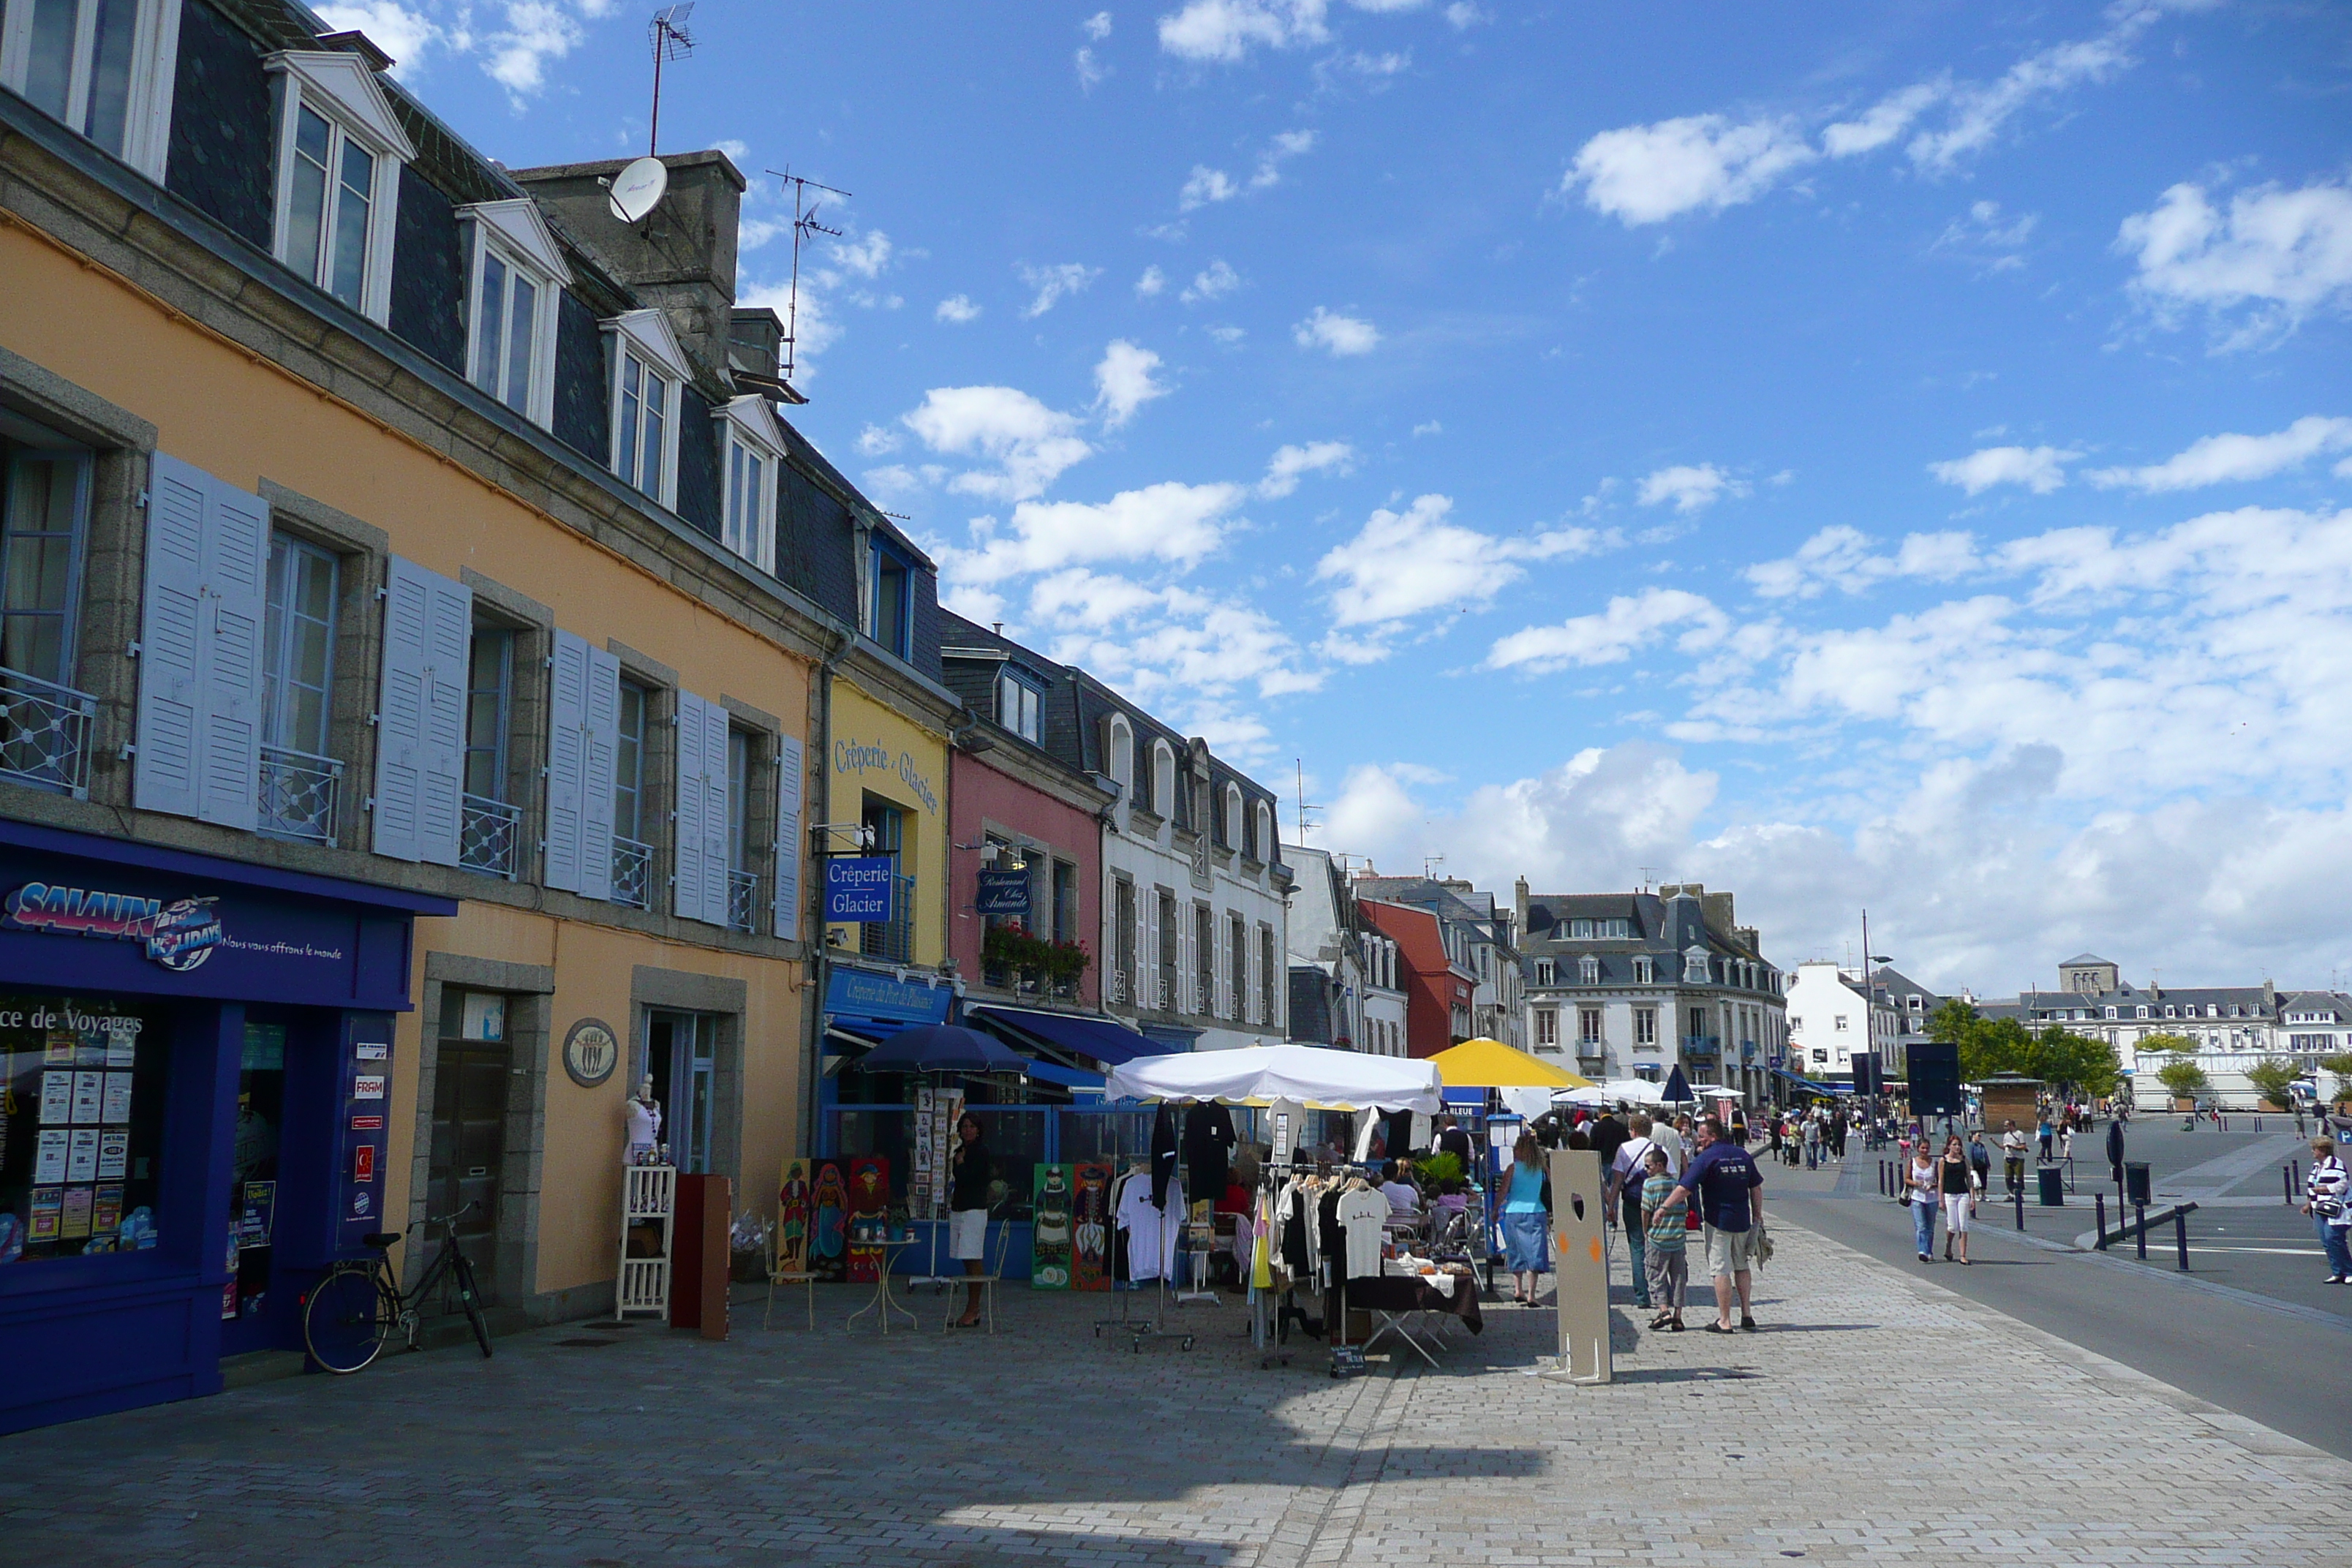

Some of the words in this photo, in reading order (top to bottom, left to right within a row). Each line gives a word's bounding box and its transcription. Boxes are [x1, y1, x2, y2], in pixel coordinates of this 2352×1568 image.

[834, 737, 888, 775] Crêperie
[899, 751, 938, 816] Glacier
[829, 864, 889, 886] Crêperie
[981, 875, 1028, 887] Restaurant
[979, 893, 1028, 909] Armande
[1003, 886, 1024, 898] Chez
[14, 881, 162, 937] SALAUN
[833, 893, 883, 913] Glacier
[151, 924, 221, 957] HOLIDAYS
[222, 935, 246, 949] Nous
[248, 943, 270, 951] vous
[271, 941, 304, 955] offrons
[306, 943, 312, 955] le
[314, 949, 342, 960] monde
[31, 1005, 56, 1030] de
[66, 1009, 143, 1038] Voyages
[356, 1082, 382, 1093] FRAM
[2341, 1131, 2351, 1142] P
